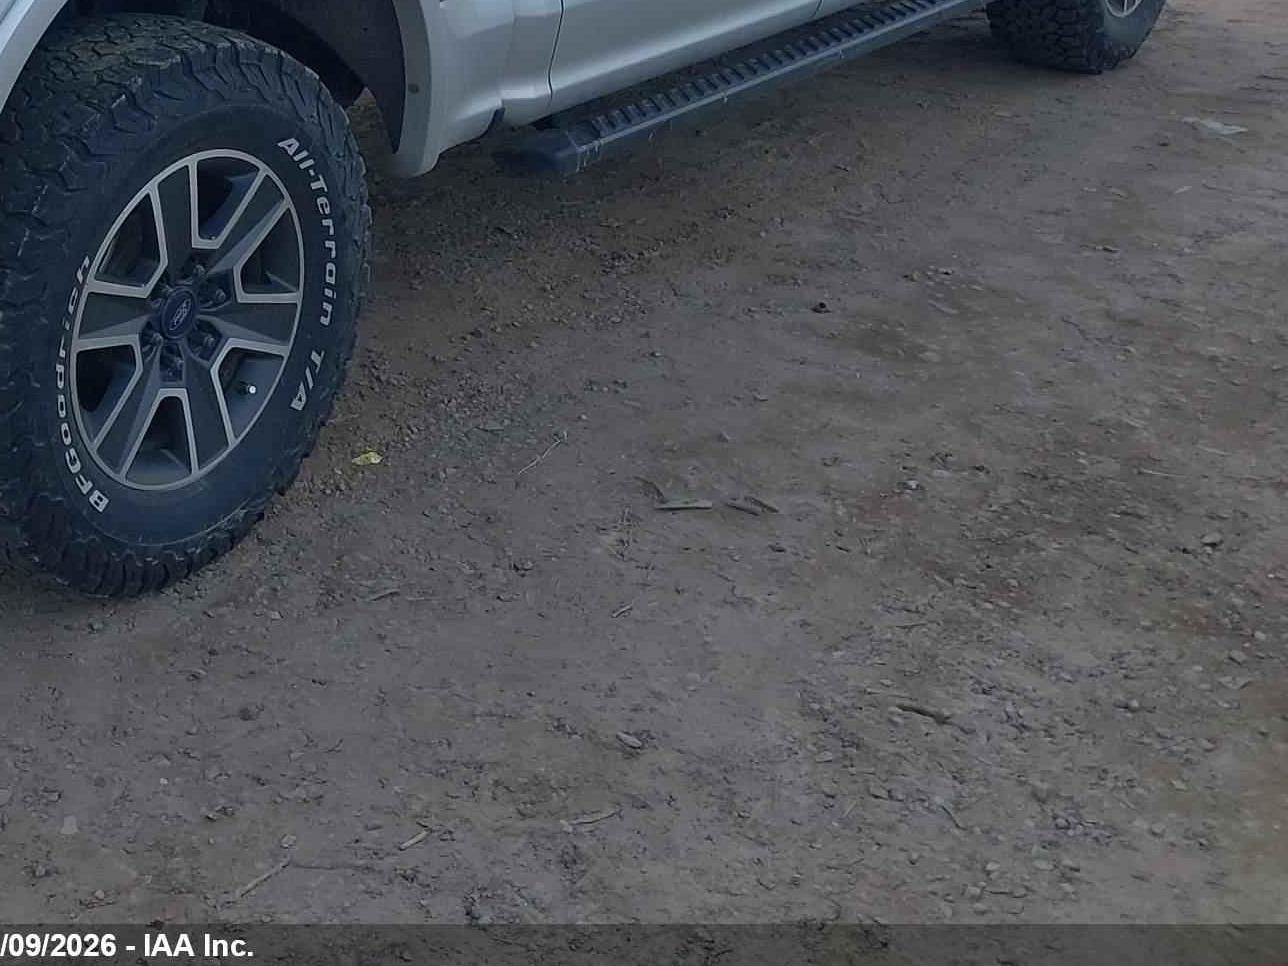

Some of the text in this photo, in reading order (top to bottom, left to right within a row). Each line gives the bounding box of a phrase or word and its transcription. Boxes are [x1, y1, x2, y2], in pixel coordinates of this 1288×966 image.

[55, 255, 110, 513] BFGoodrich
[277, 137, 336, 411] All-Terrain T/A
